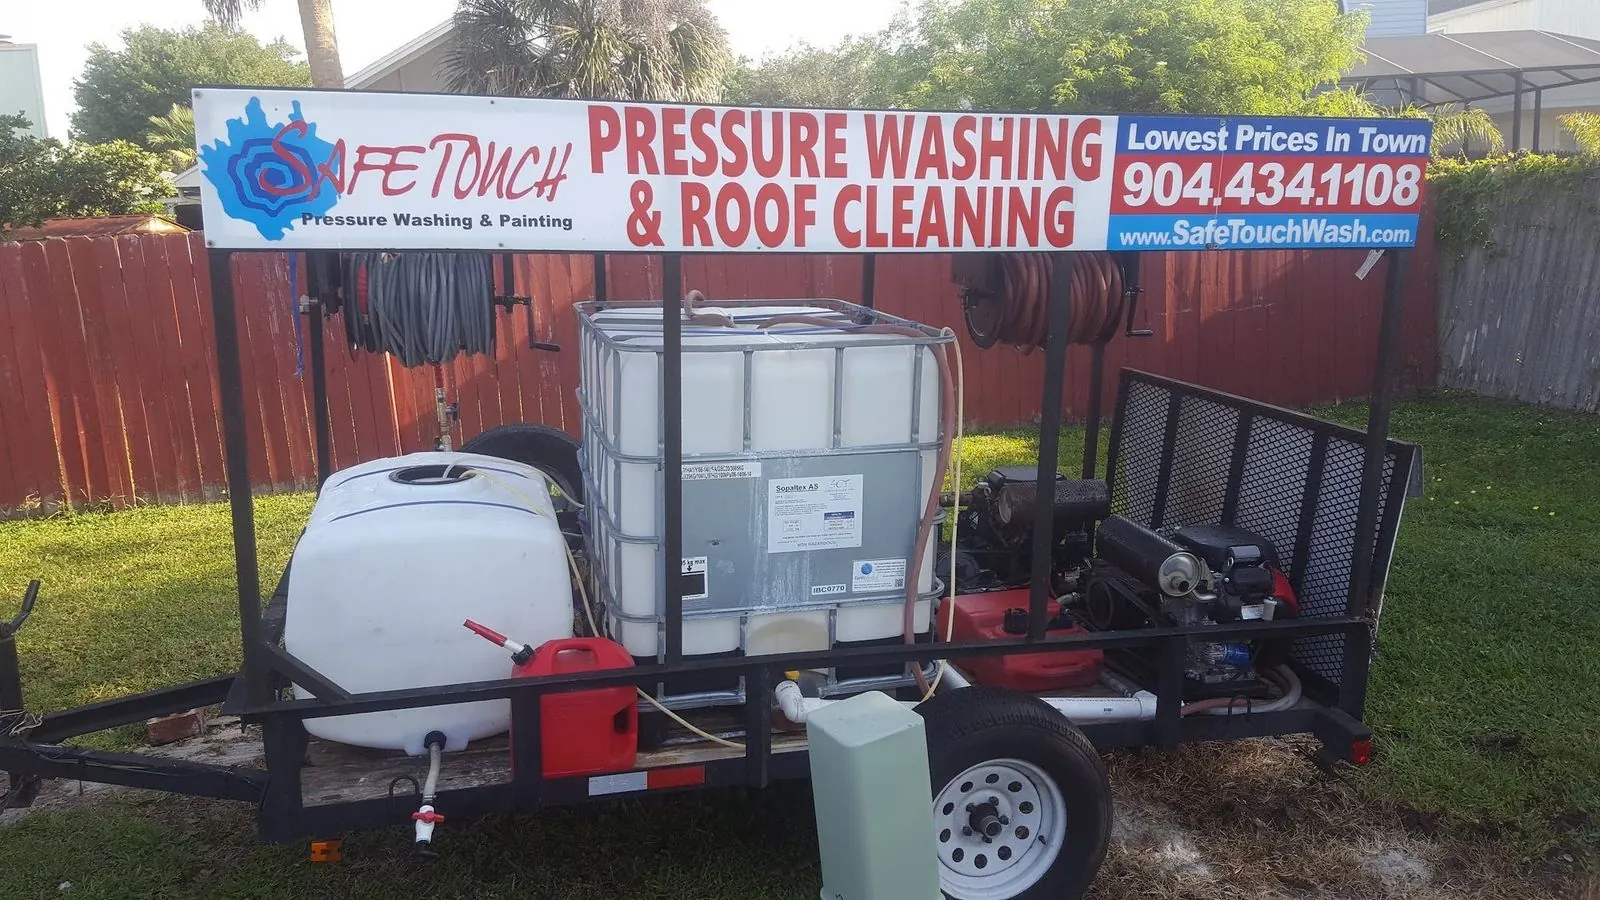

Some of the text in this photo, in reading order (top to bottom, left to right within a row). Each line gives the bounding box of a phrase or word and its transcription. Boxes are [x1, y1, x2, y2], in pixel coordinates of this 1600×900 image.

[588, 104, 1103, 182] PRESSURE WASHING
[1127, 122, 1427, 154] Lowest Prices In Town
[1123, 161, 1421, 207] 904.434.1108
[301, 212, 574, 230] Pressure Washing & Painting
[626, 179, 1076, 249] & ROOF CLEANING
[813, 585, 845, 594] IBC0770
